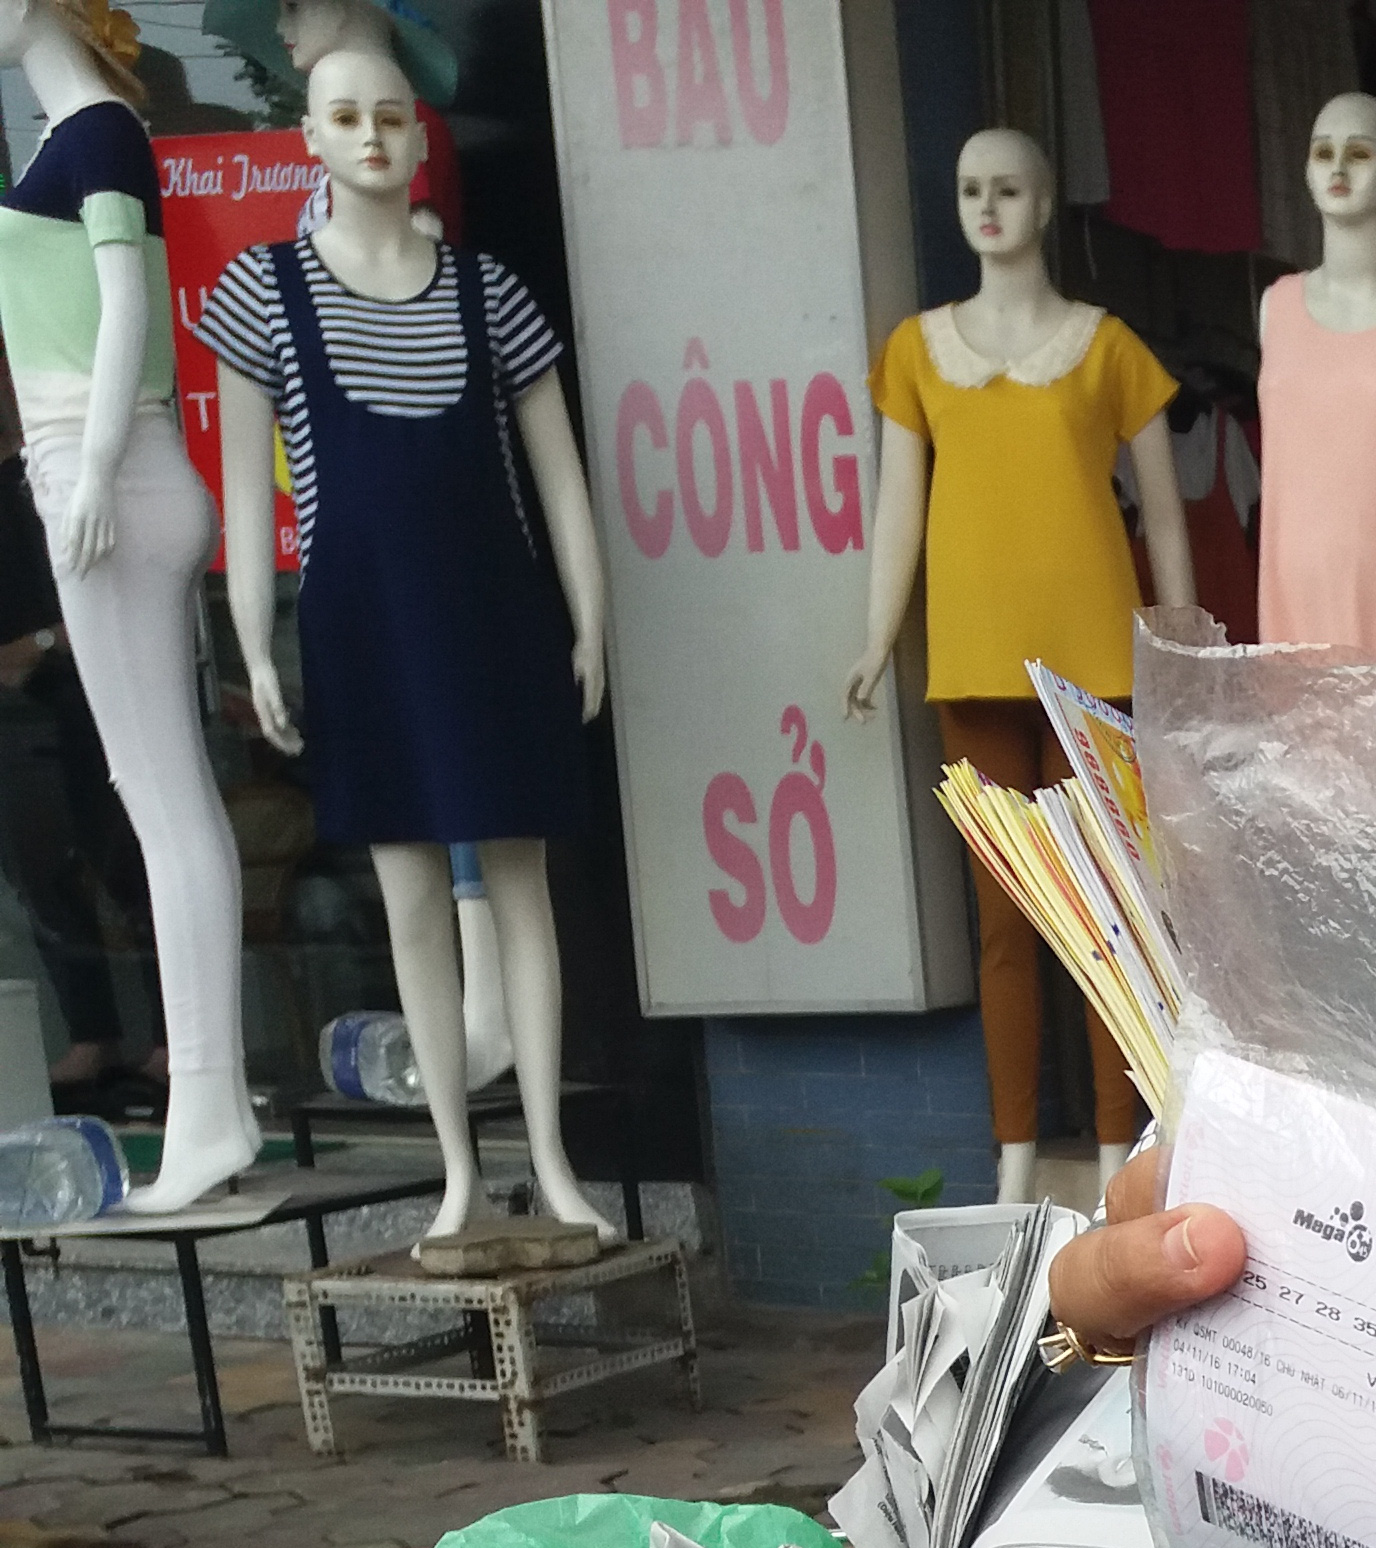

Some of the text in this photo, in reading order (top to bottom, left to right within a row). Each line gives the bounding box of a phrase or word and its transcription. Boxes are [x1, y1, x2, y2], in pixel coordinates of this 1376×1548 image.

[161, 156, 224, 197] Khai
[616, 337, 864, 560] CÔNG
[703, 705, 837, 944] SỞ
[1292, 1208, 1345, 1243] Mega
[1243, 1269, 1267, 1291] 25
[1280, 1285, 1304, 1305] 27
[1315, 1301, 1341, 1321] 28
[1173, 1338, 1256, 1385] 04/11/16 17:04
[1222, 1335, 1271, 1367] 00048/16
